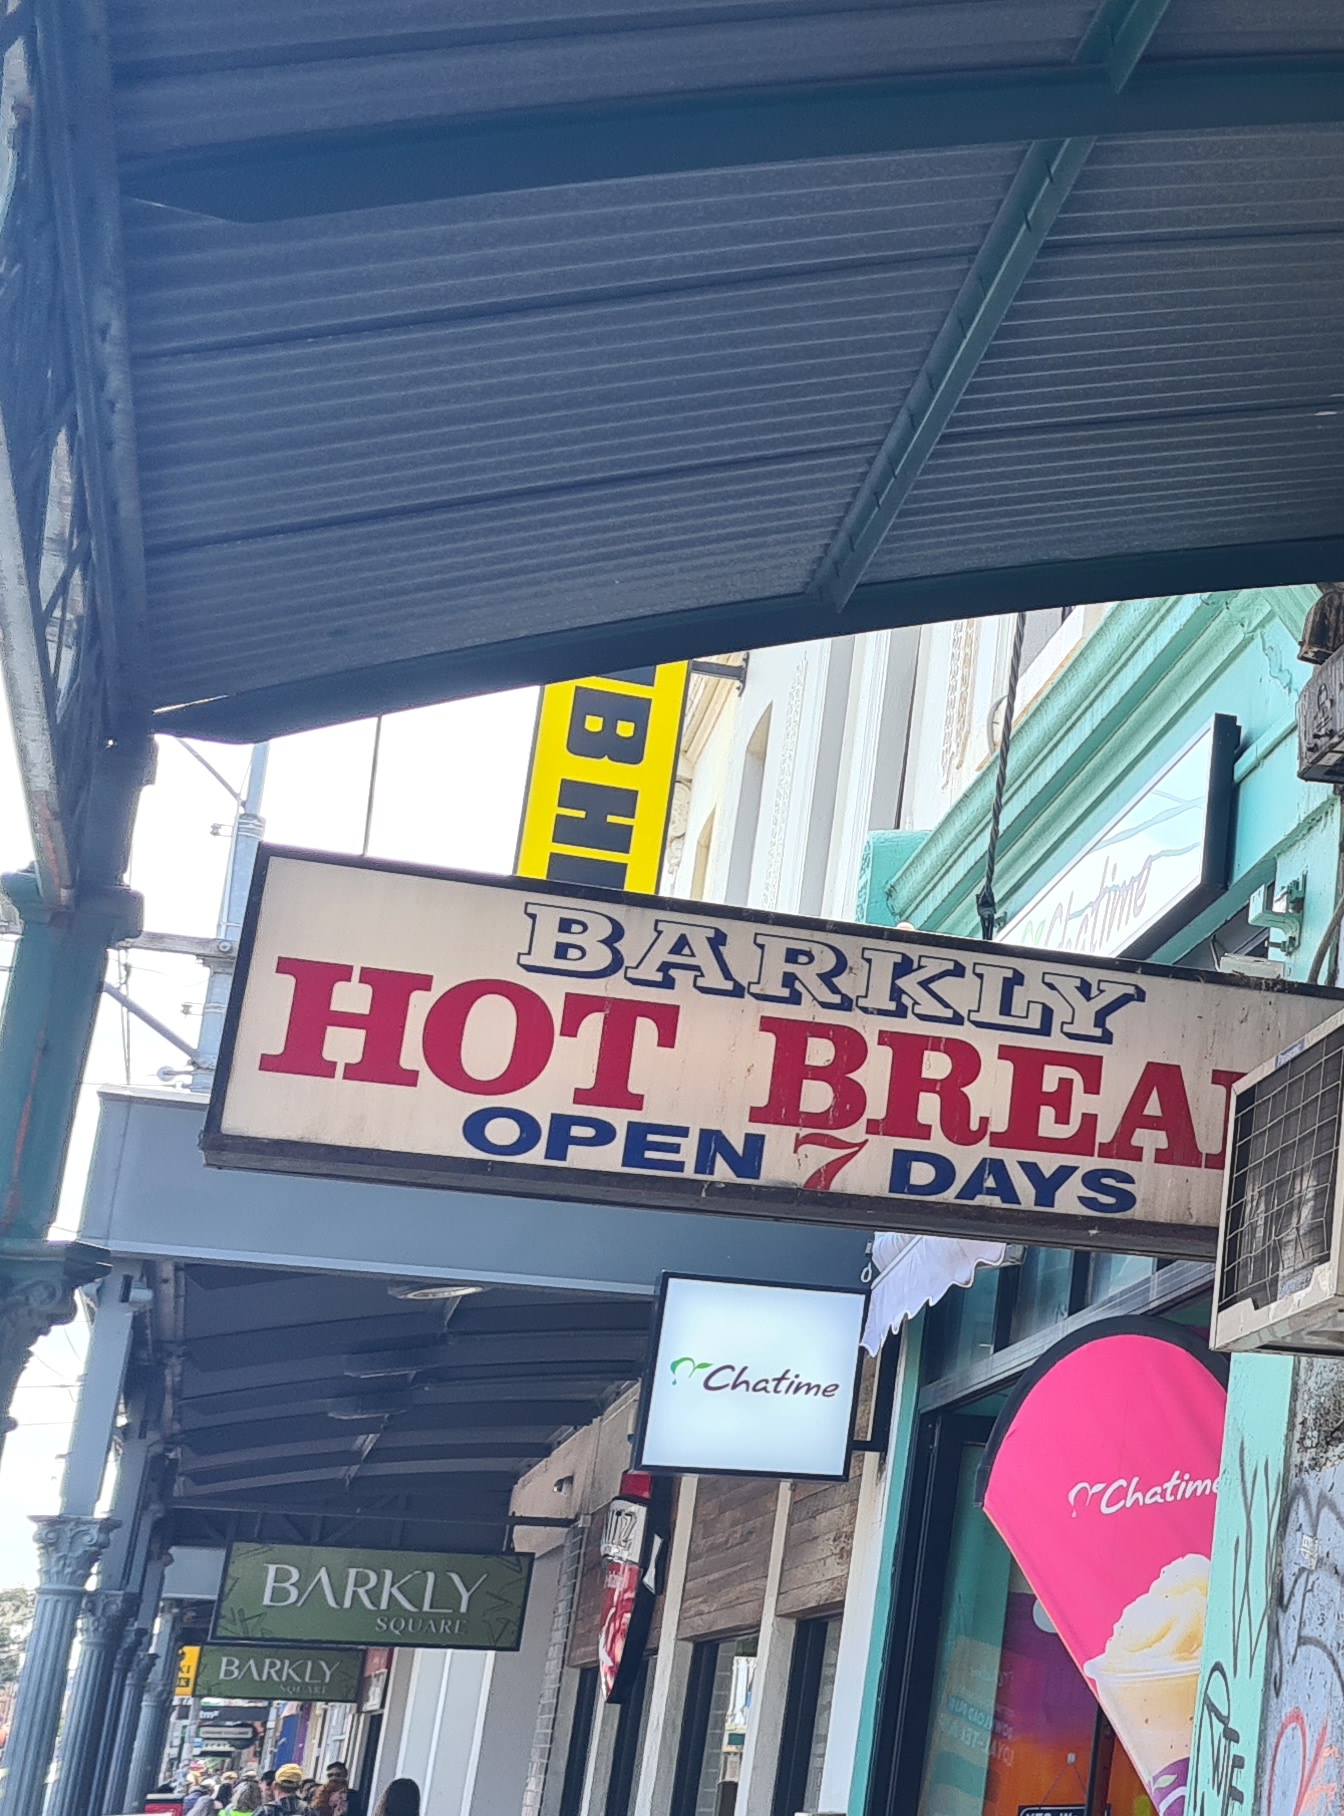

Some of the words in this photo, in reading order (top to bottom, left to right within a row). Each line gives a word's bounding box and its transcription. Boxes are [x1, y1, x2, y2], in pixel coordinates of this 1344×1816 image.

[517, 902, 1147, 1045] BARKLY
[258, 956, 680, 1112] HOT
[748, 1015, 1246, 1170] BREA
[462, 1106, 766, 1180] OPEN
[794, 1132, 869, 1191] 7
[888, 1148, 1138, 1213] DAYS
[703, 1364, 840, 1398] Chatime
[262, 1563, 489, 1614] BARKLY
[375, 1615, 467, 1635] SQUARE
[218, 1656, 341, 1684] BARKLY
